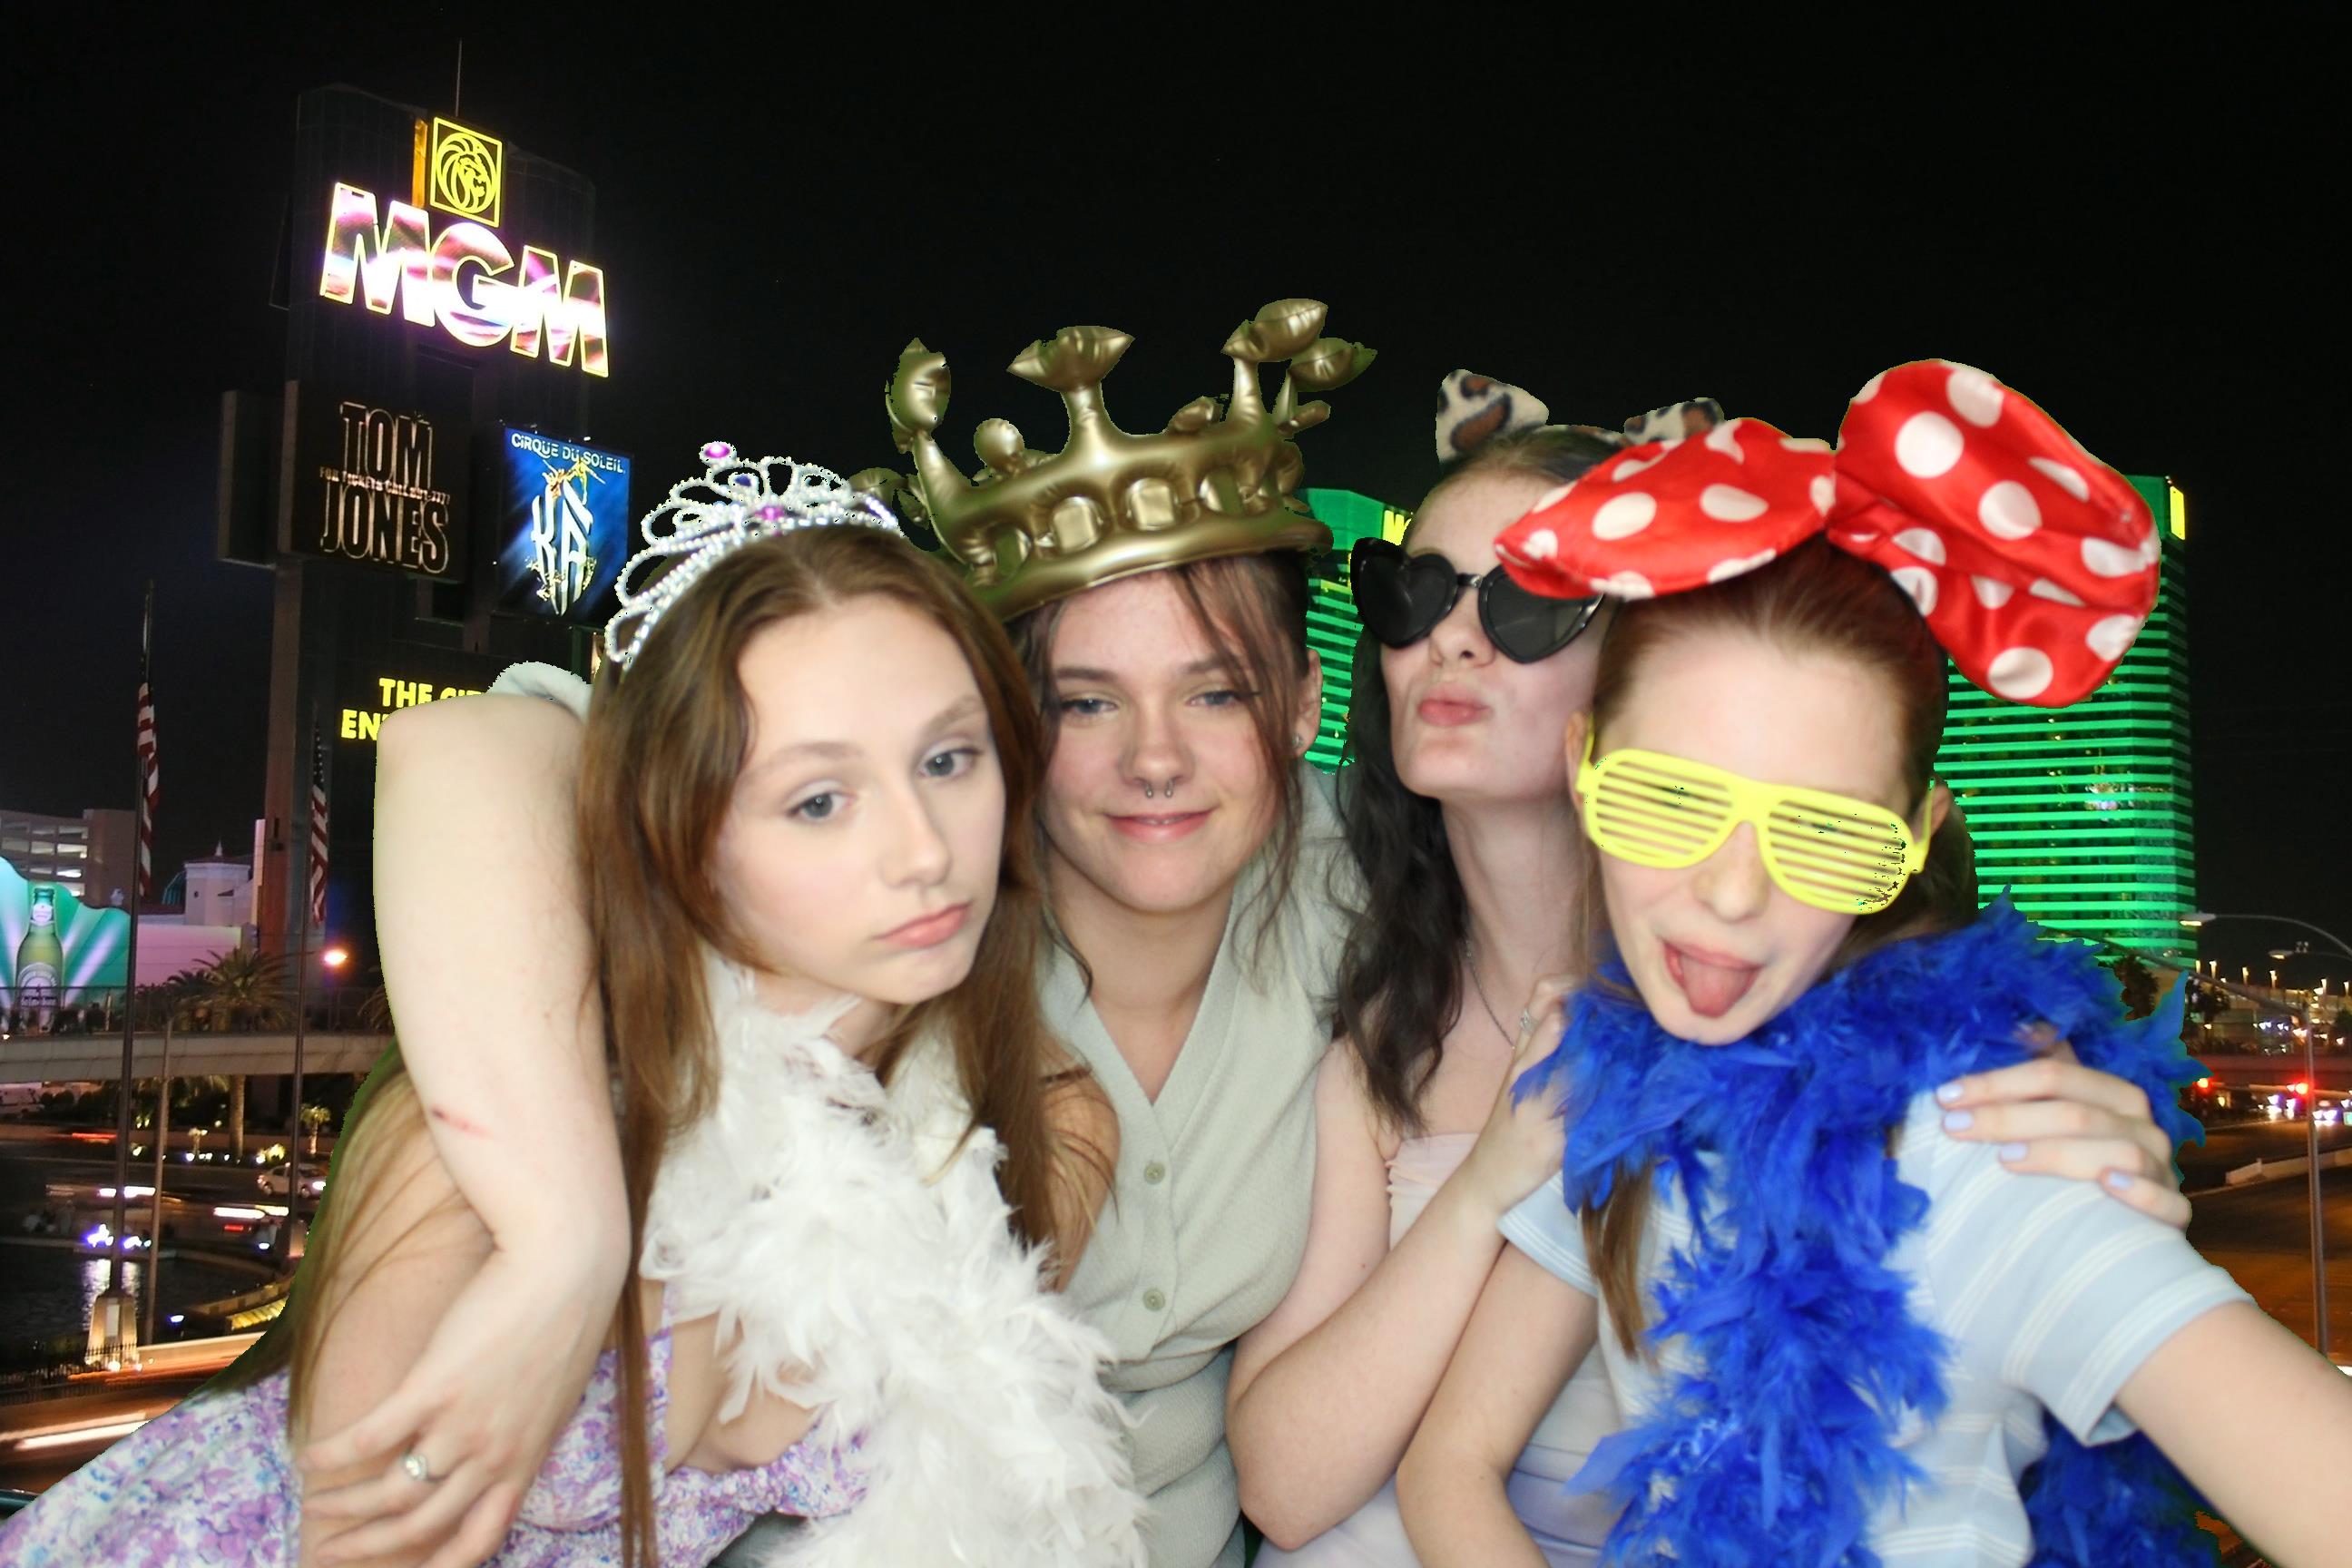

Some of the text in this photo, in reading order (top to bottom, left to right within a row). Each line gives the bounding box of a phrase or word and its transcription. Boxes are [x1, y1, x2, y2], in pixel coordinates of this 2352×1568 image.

[319, 182, 609, 377] MGM
[339, 401, 433, 491] TOM
[562, 446, 580, 463] DU
[320, 477, 449, 573] JONES
[378, 677, 433, 708] THE
